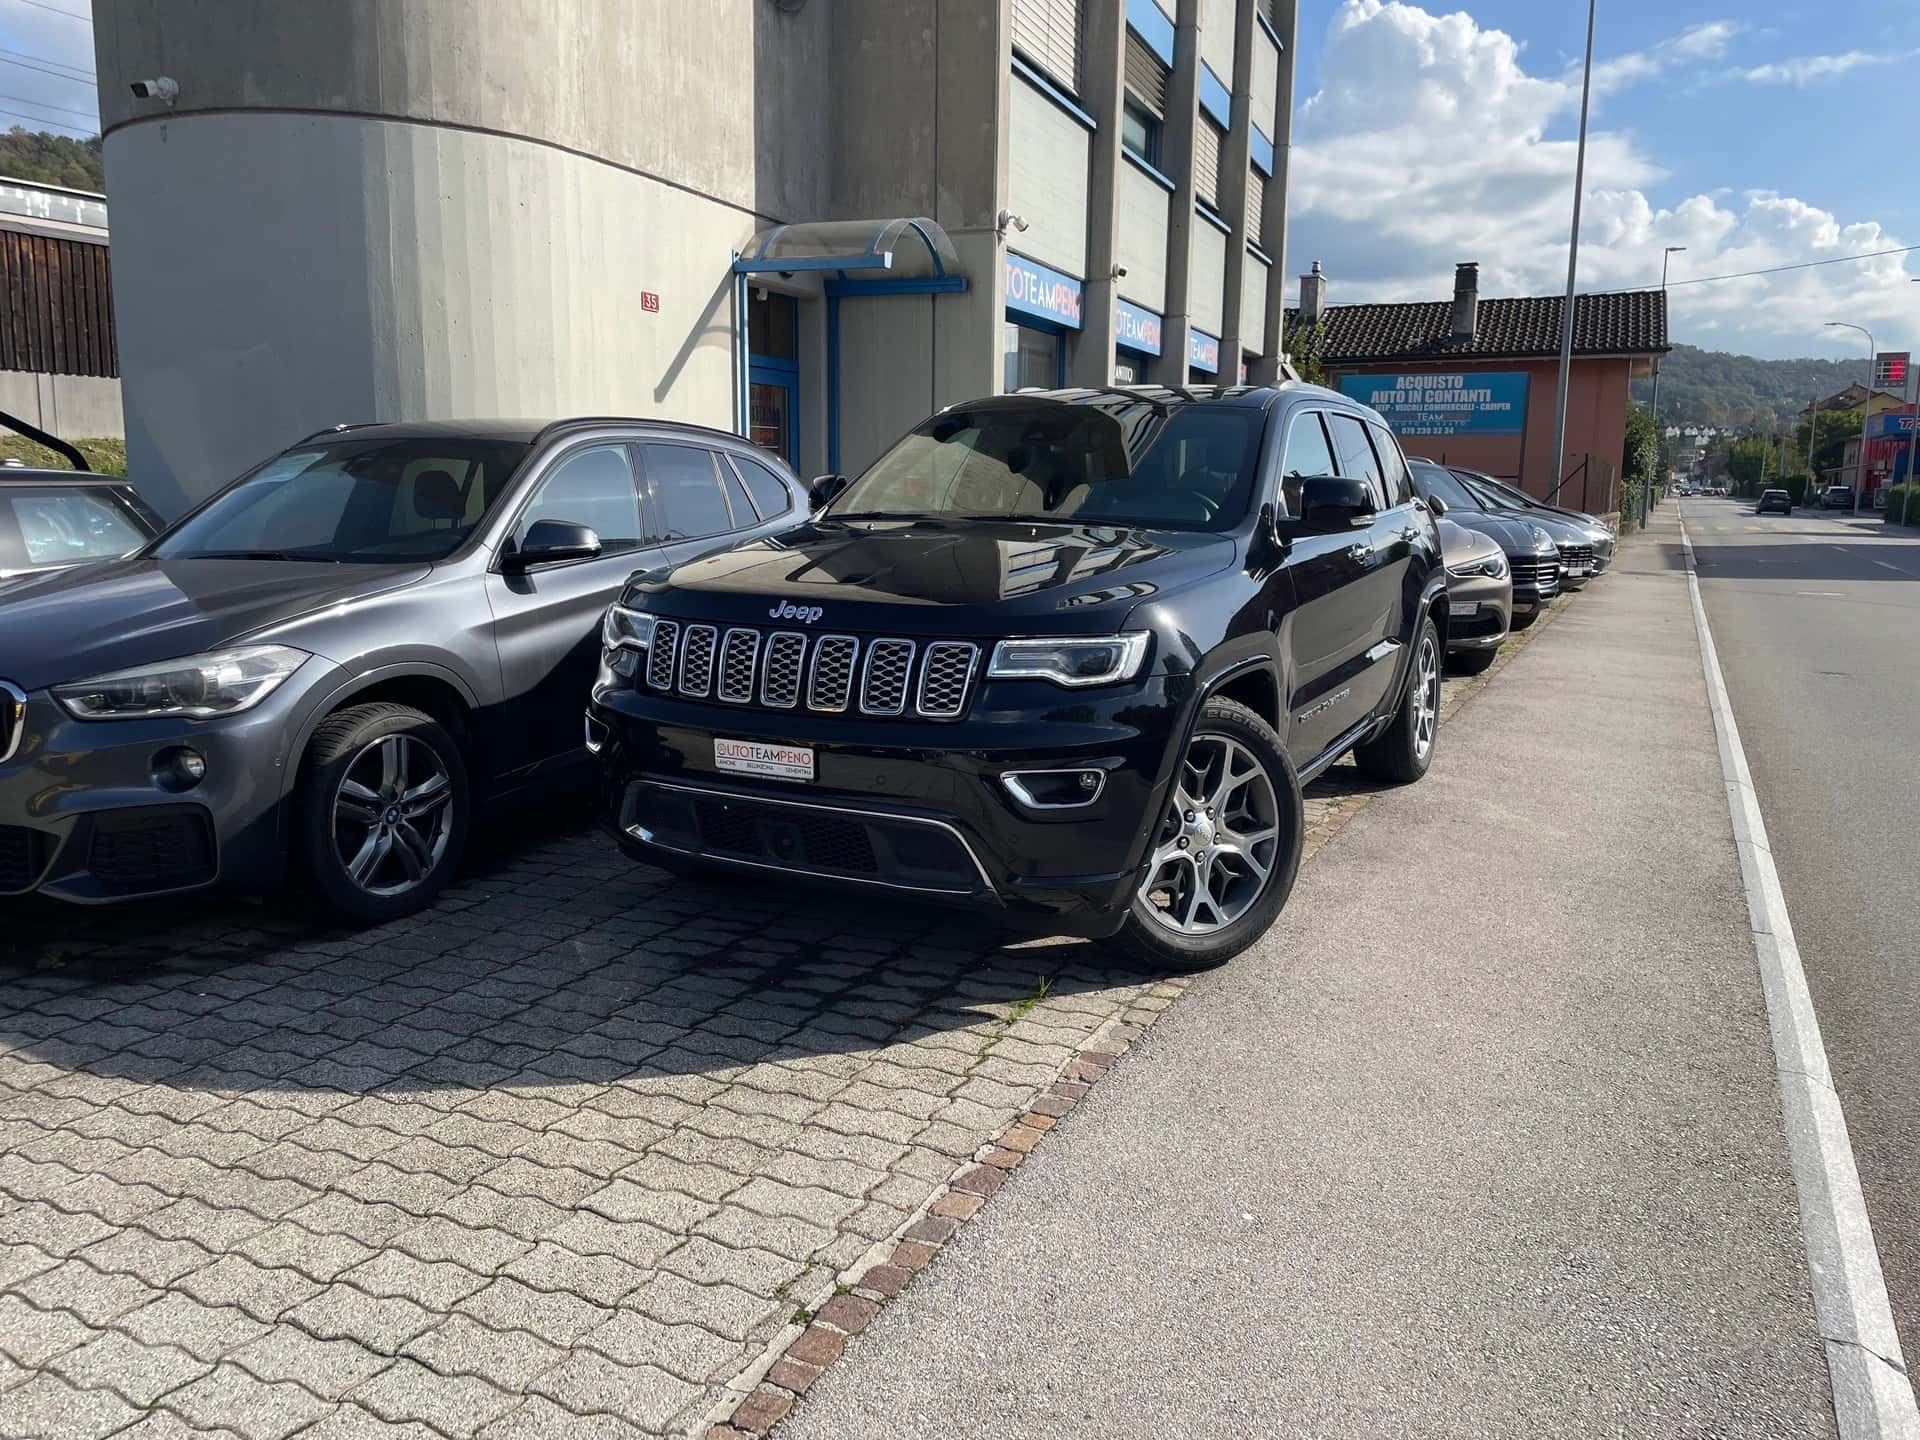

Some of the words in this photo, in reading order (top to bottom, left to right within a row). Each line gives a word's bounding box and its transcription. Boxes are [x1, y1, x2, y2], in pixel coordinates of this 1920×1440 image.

[645, 293, 657, 308] 35
[1396, 376, 1464, 390] ACQUISTO
[1371, 390, 1406, 403] AUTO
[1408, 390, 1422, 403] IN
[1424, 388, 1491, 403] CONTANTI
[1423, 403, 1475, 411] COMMERCIALI
[1480, 402, 1511, 411] CAMPER
[1417, 412, 1444, 421] TEAM
[769, 599, 823, 624] Jeep
